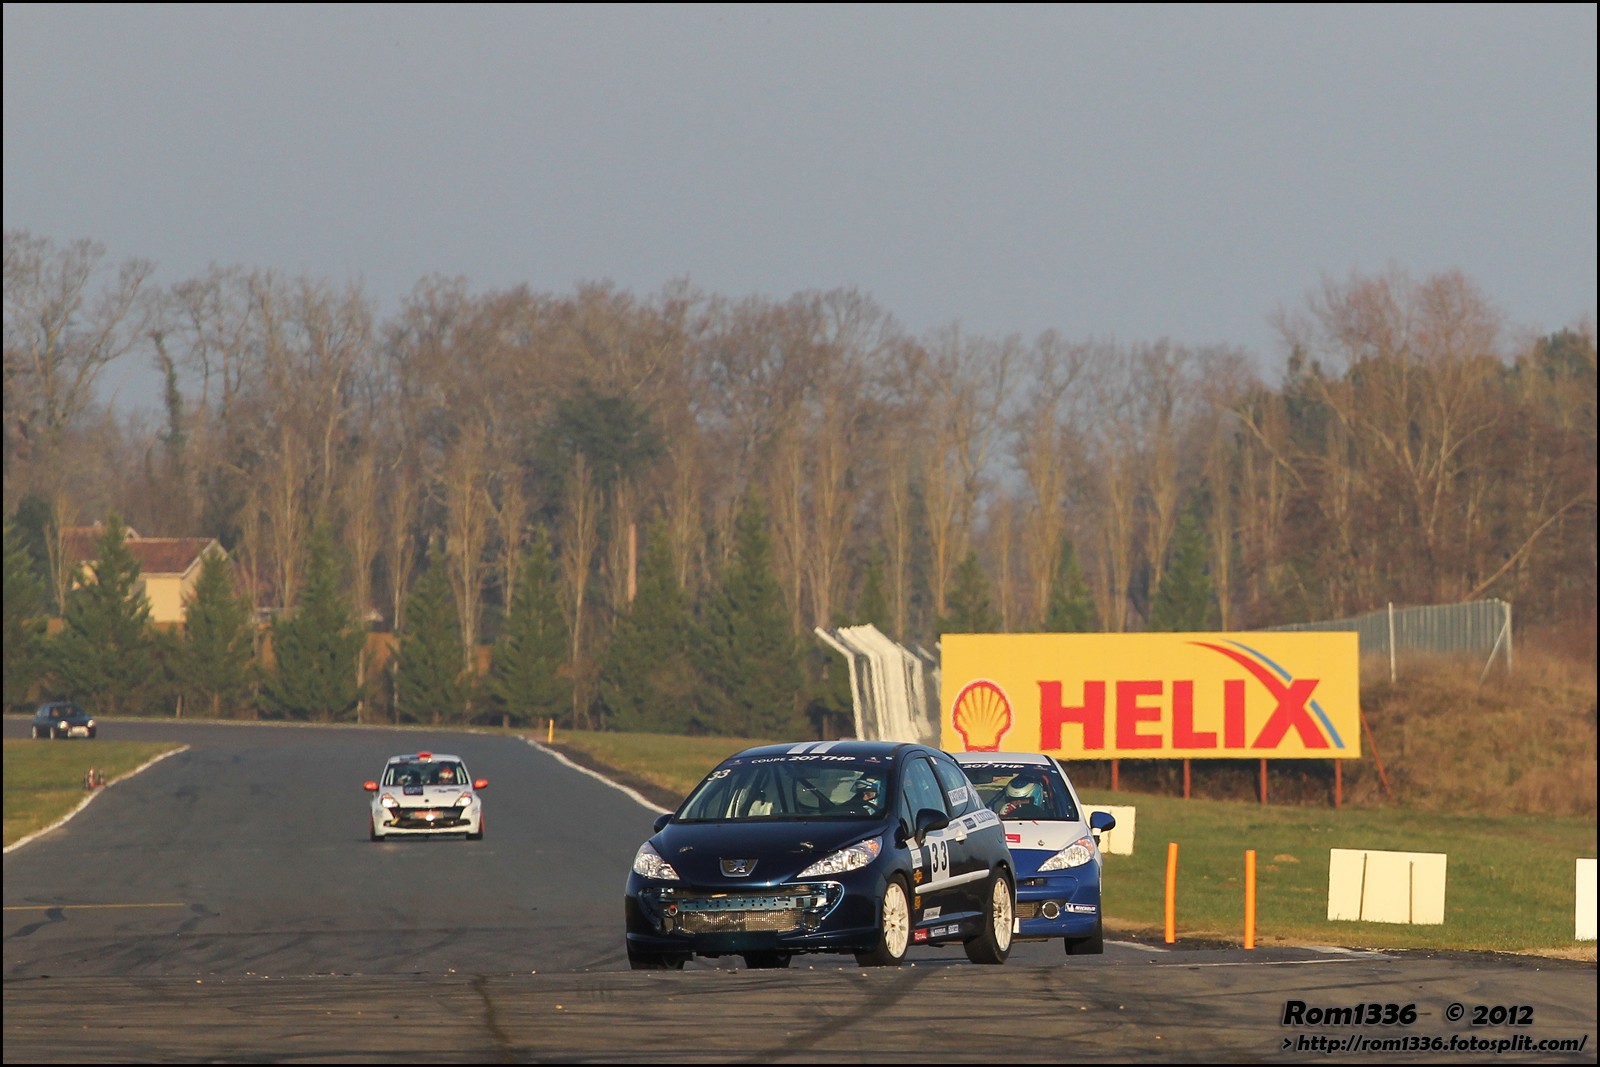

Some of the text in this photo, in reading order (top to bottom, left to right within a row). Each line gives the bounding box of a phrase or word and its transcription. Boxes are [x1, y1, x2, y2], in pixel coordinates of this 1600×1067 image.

[1036, 679, 1330, 750] HELIX
[707, 768, 732, 781] 33
[931, 840, 947, 873] 33
